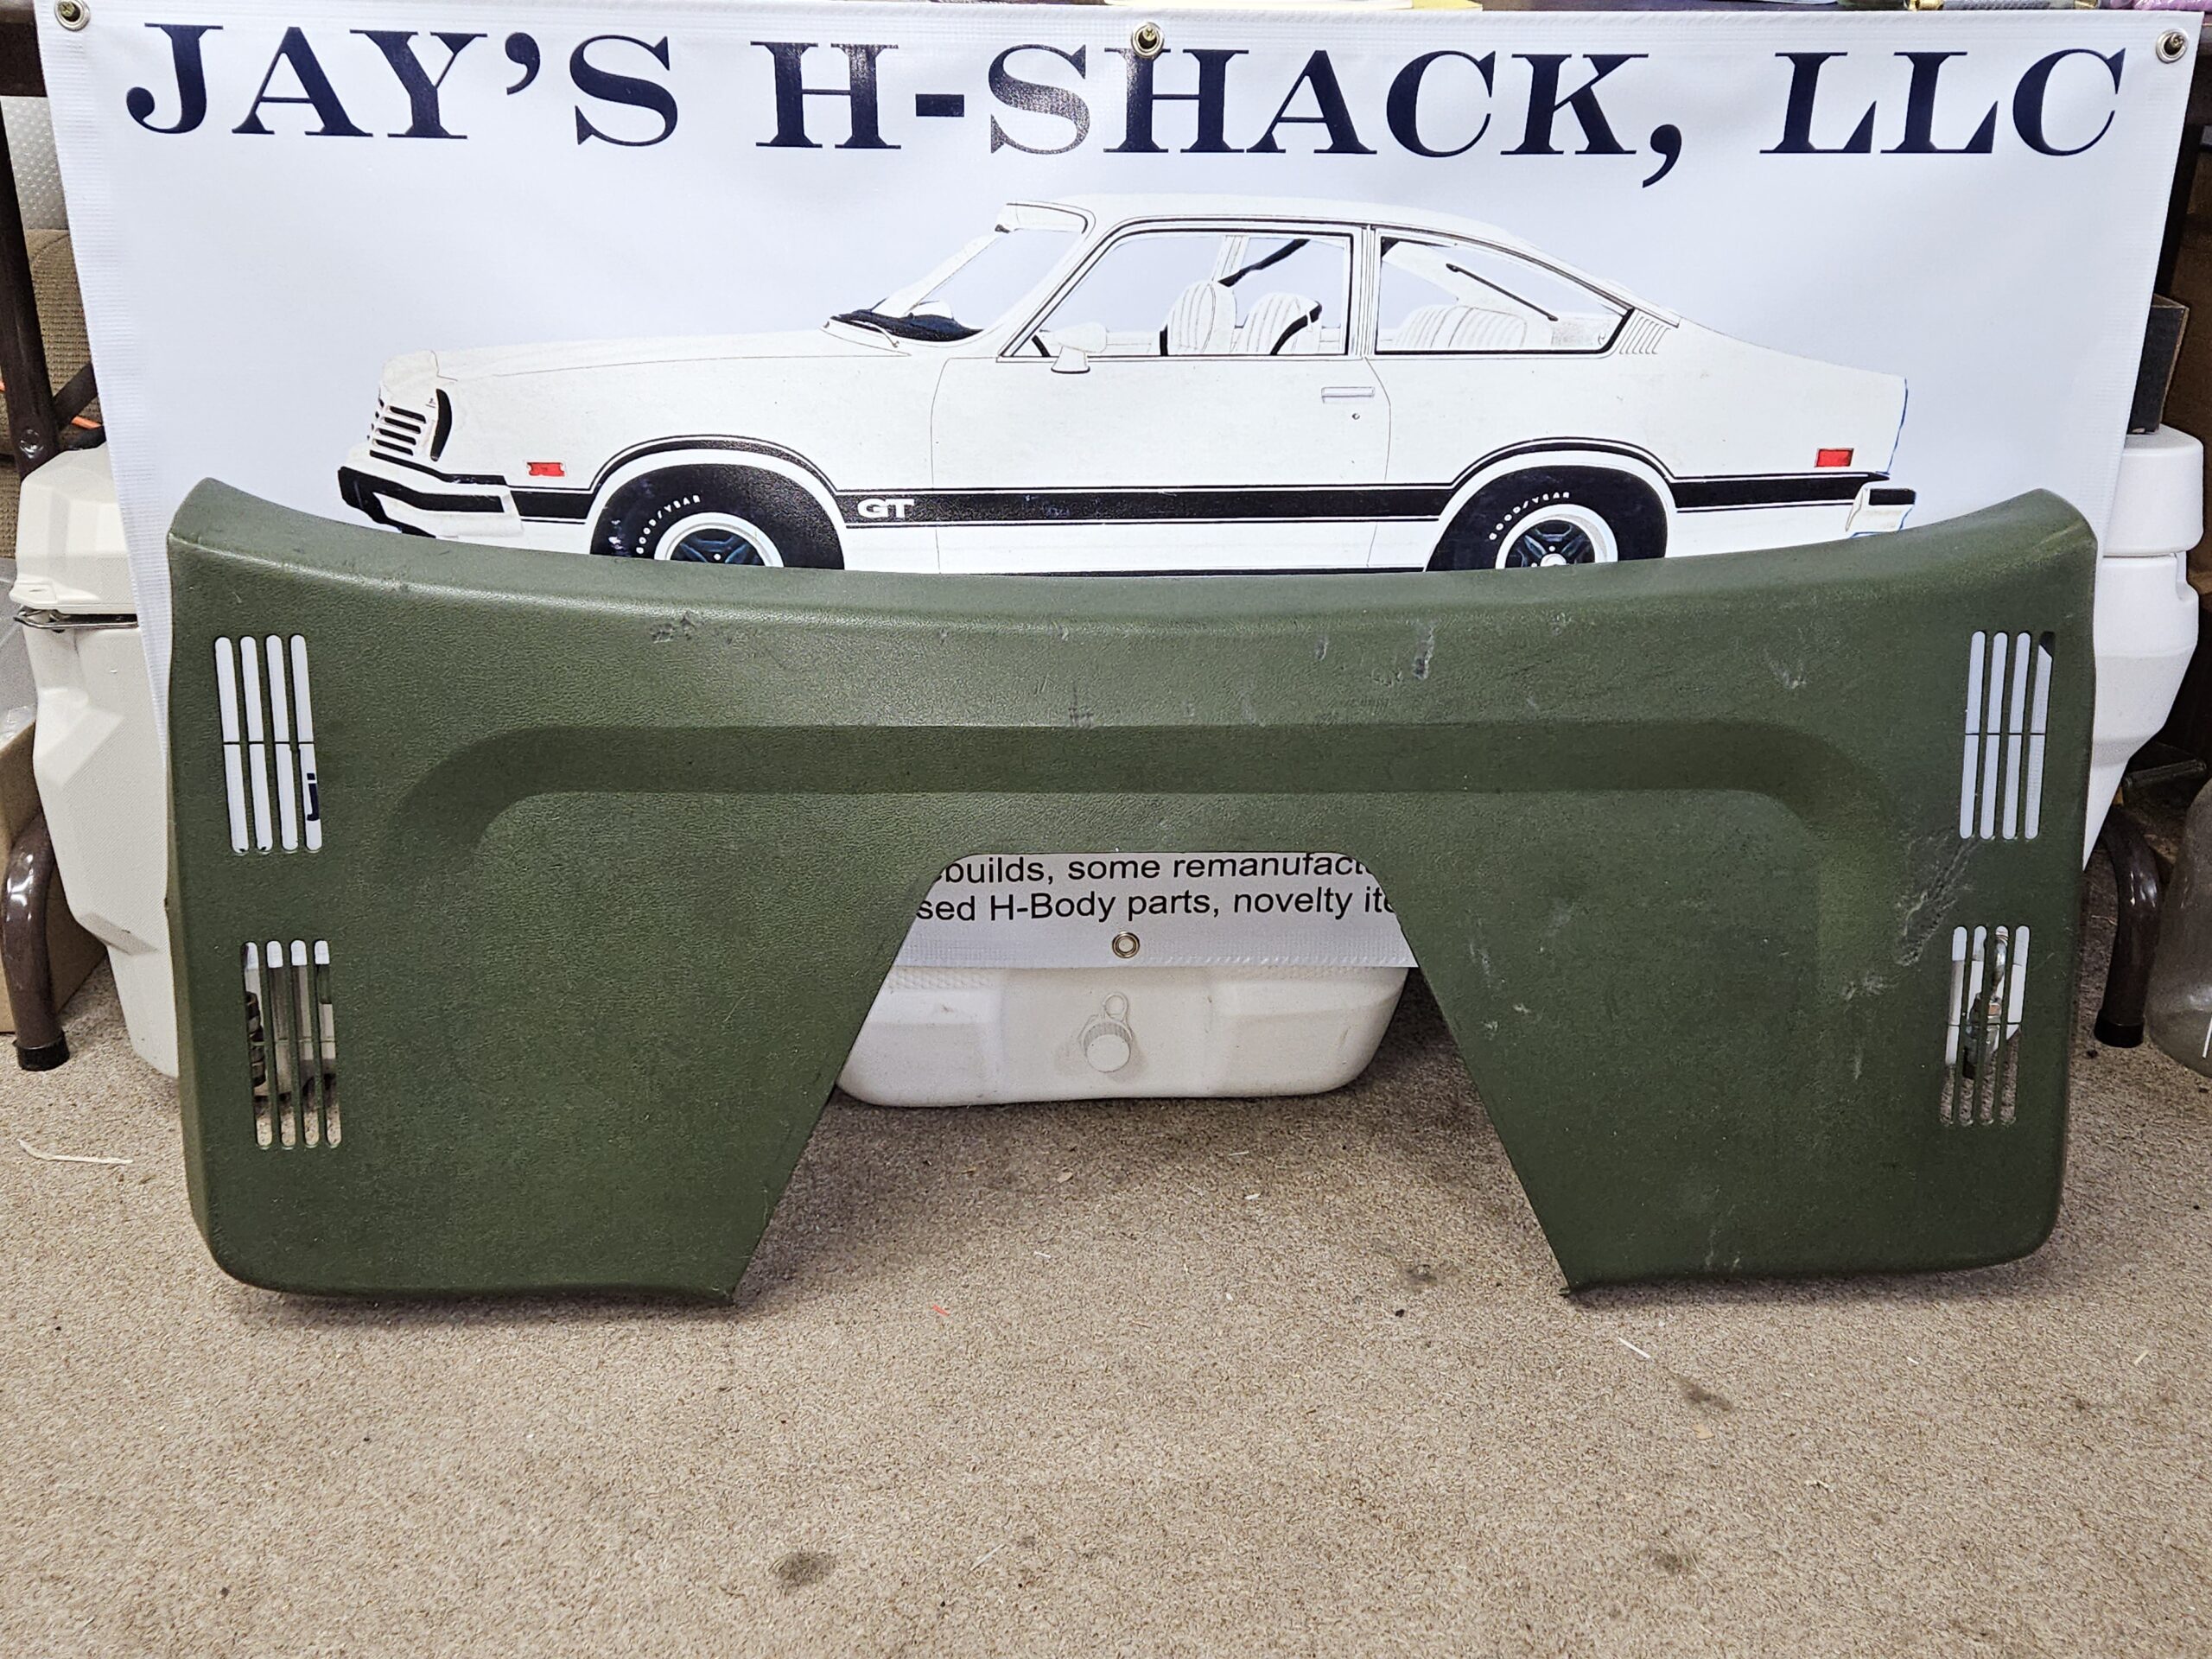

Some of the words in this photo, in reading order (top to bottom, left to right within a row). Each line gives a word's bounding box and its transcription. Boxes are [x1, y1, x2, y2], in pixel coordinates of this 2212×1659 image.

[126, 23, 678, 146] JAY'S
[750, 41, 1682, 188] H-SHACK,
[1759, 48, 2126, 157] LLC
[857, 498, 915, 518] GT
[934, 856, 1053, 886] builds,
[1068, 860, 1160, 880] some
[1173, 853, 1372, 878] remanufact
[991, 890, 1116, 923] H-Body
[1128, 889, 1219, 922] parts,
[1234, 886, 1353, 920] novelty
